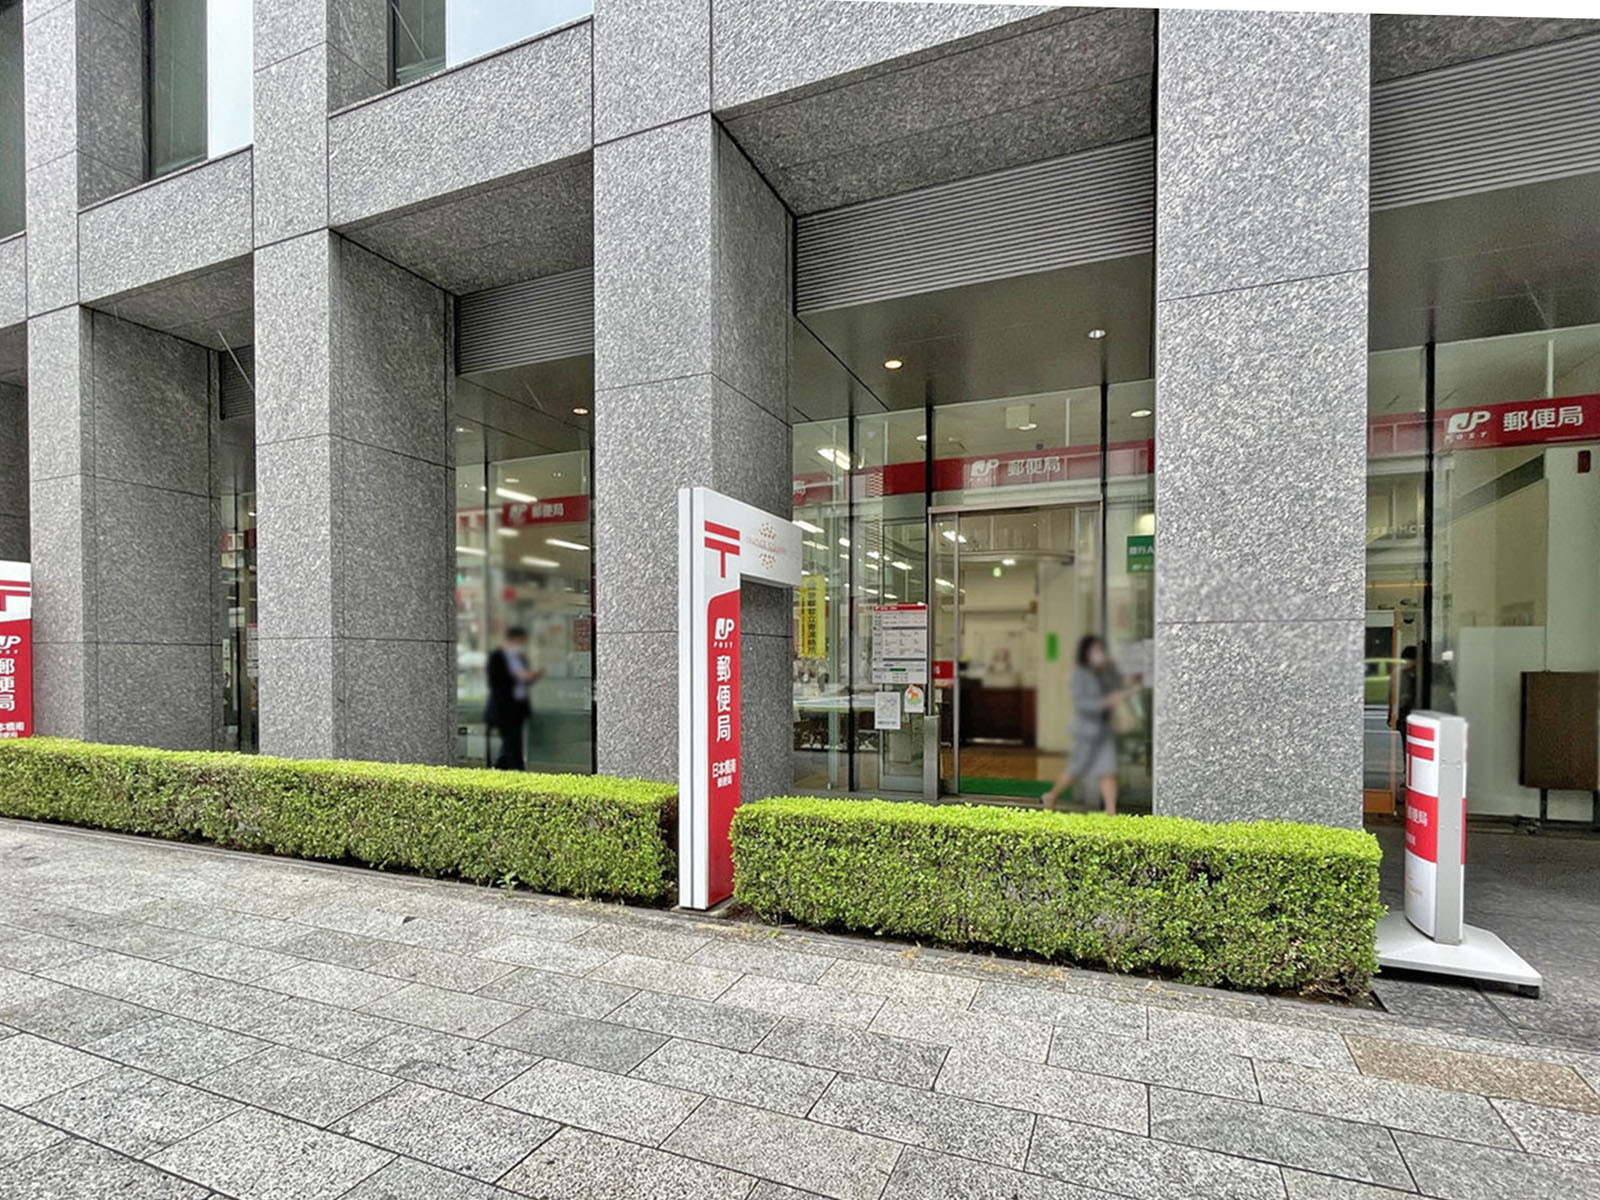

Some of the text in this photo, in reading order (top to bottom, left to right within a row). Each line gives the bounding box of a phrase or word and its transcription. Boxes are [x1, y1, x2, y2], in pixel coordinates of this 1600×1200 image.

[1503, 406, 1583, 431] 郵便局
[1007, 455, 1061, 477] 郵便局
[713, 641, 734, 649] POST
[717, 655, 731, 742] 郵便局
